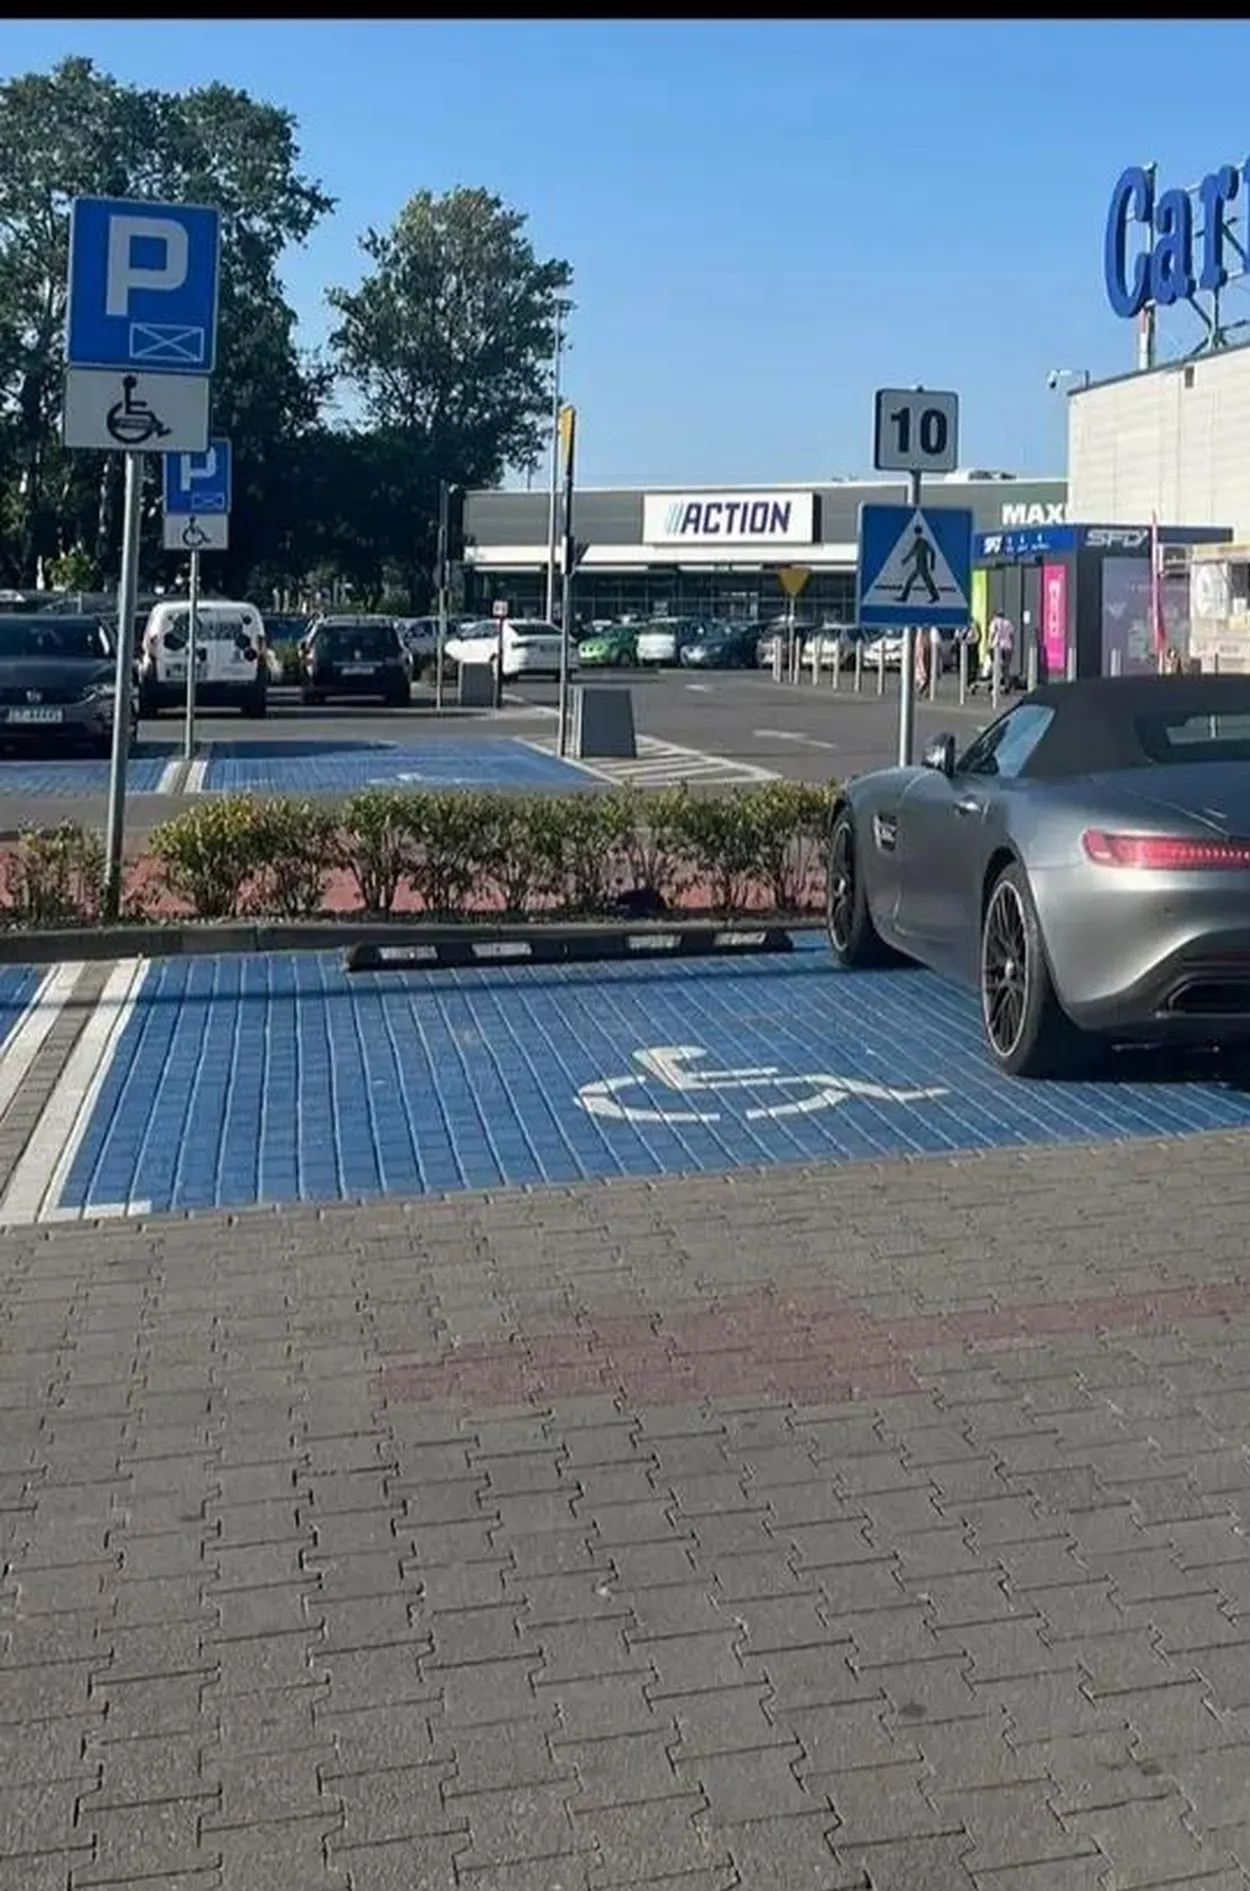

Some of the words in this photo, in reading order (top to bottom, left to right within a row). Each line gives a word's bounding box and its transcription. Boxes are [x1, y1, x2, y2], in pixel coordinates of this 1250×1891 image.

[106, 215, 189, 316] P
[891, 406, 948, 455] 10
[180, 448, 217, 491] P
[680, 501, 792, 534] ACTION
